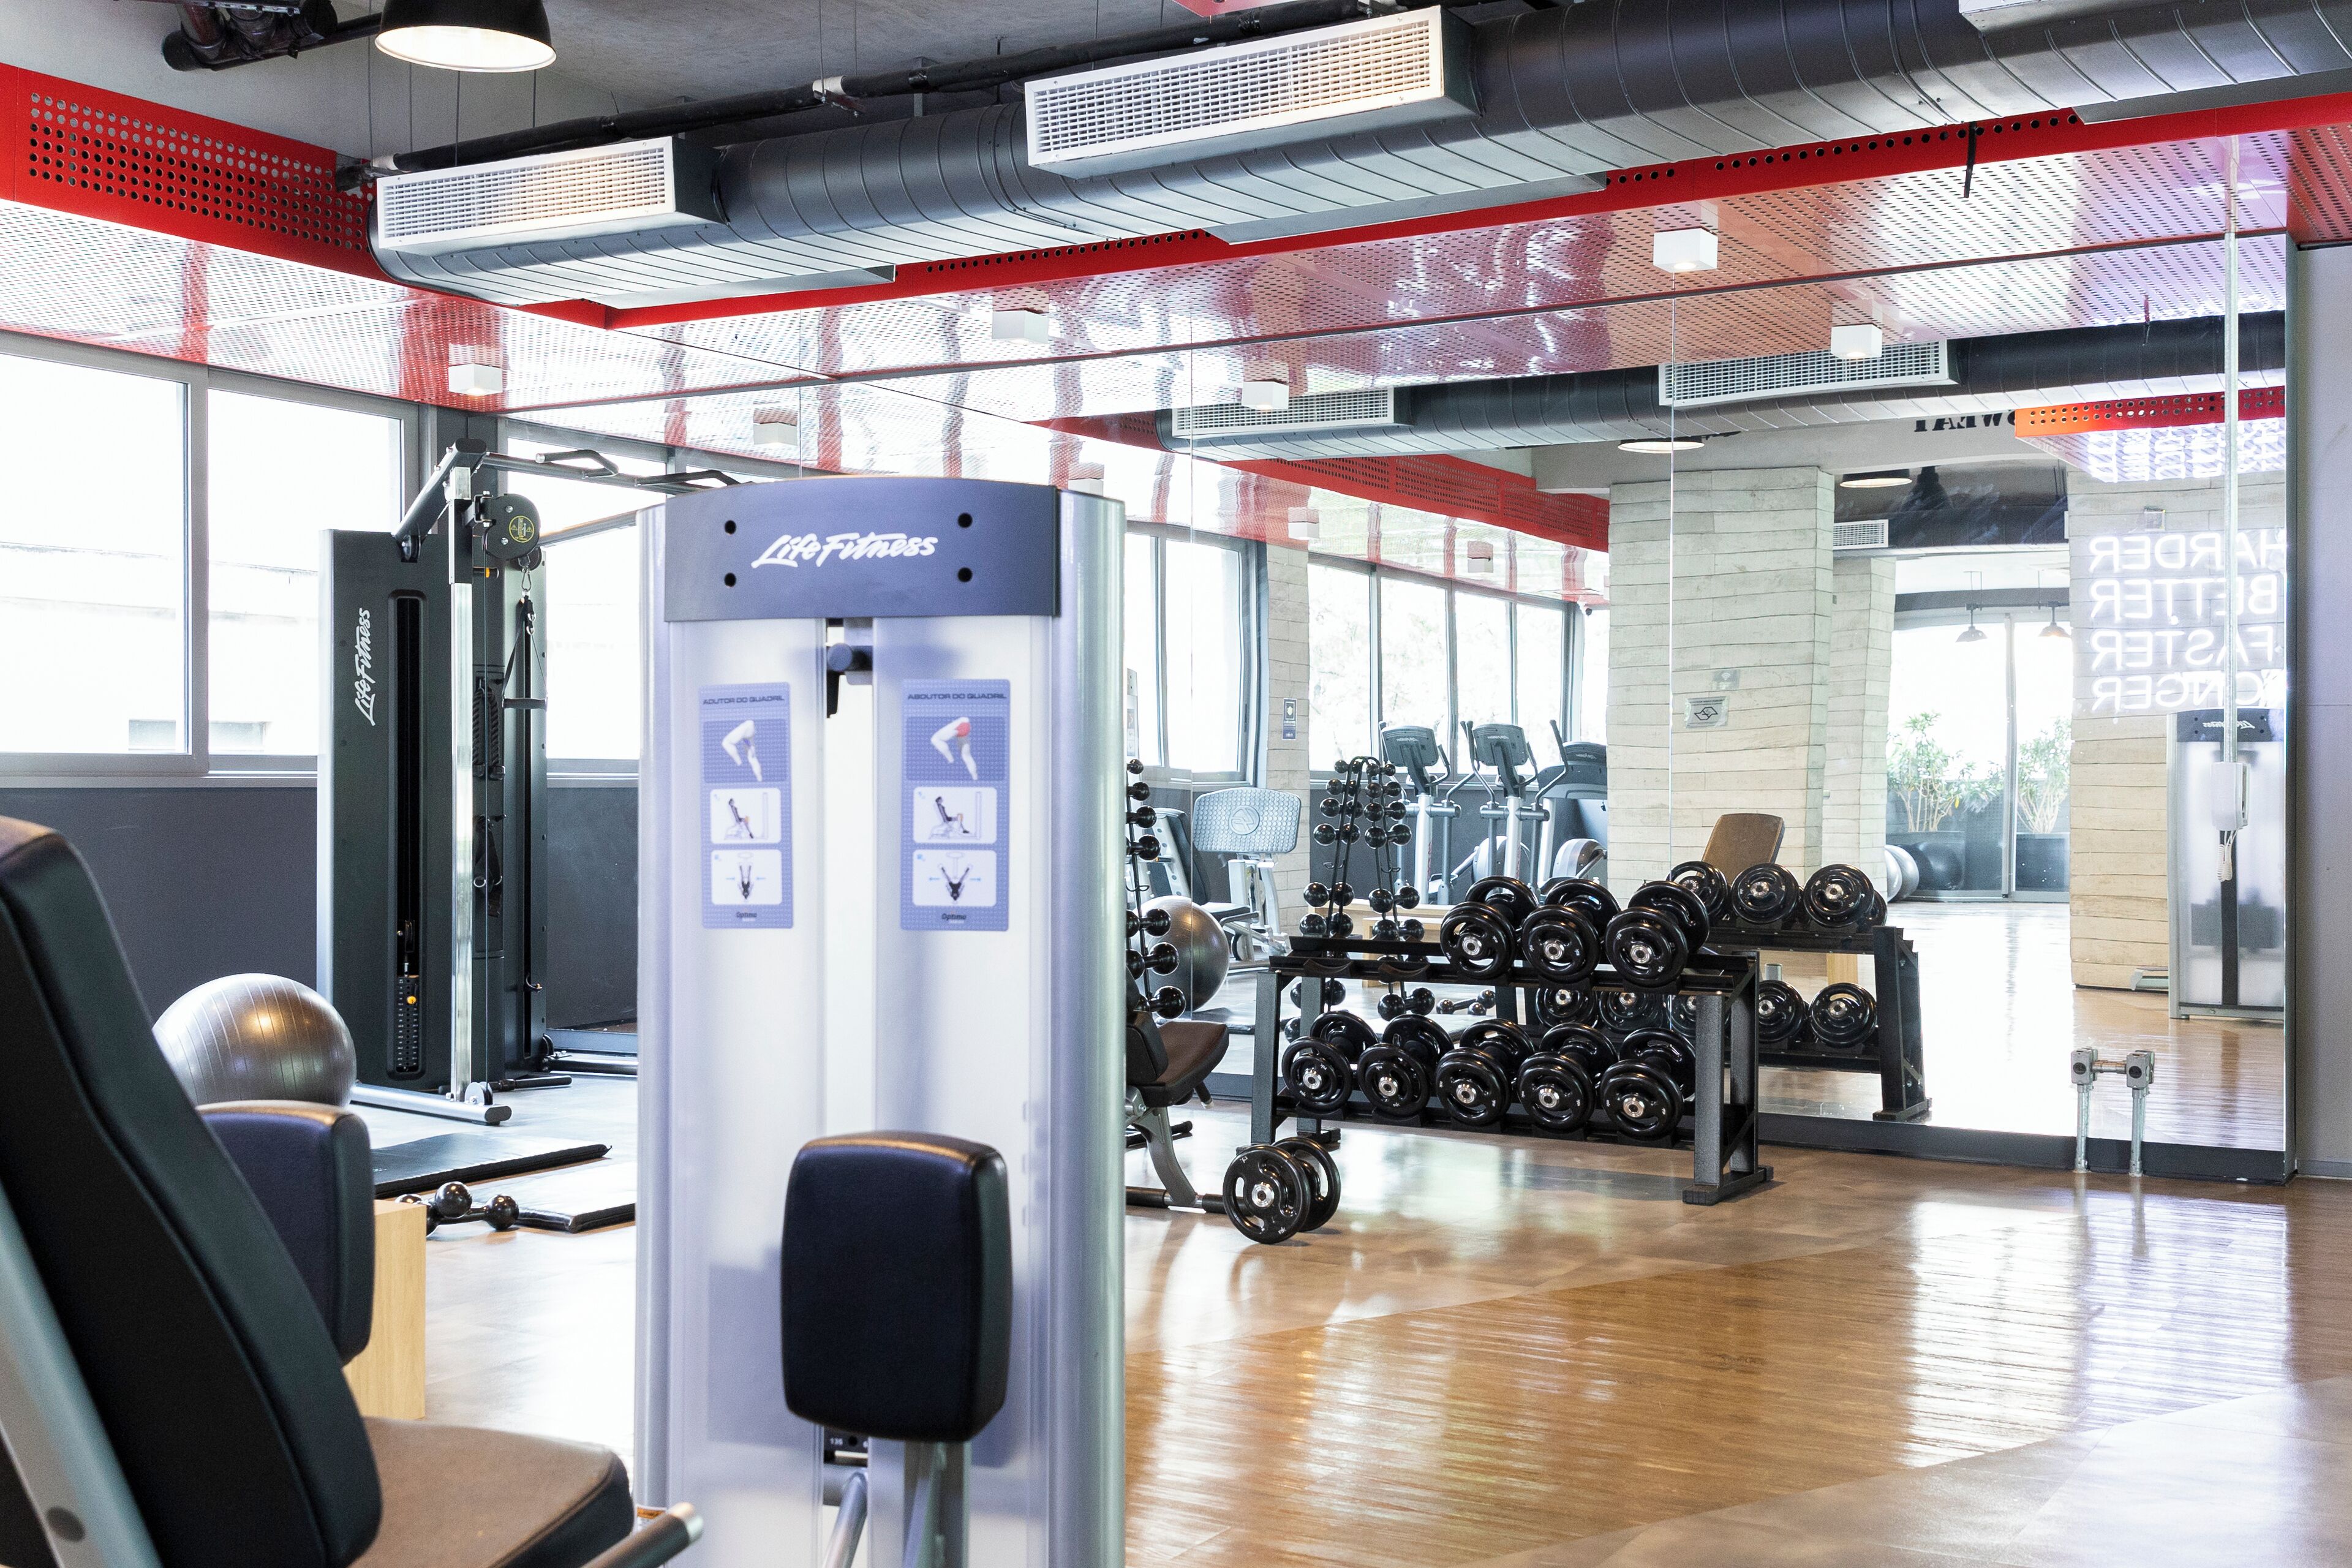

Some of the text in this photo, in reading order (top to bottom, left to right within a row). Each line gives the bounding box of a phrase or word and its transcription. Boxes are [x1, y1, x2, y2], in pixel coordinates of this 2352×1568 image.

[751, 532, 938, 568] Life Fitness
[355, 608, 376, 726] Life Fitness
